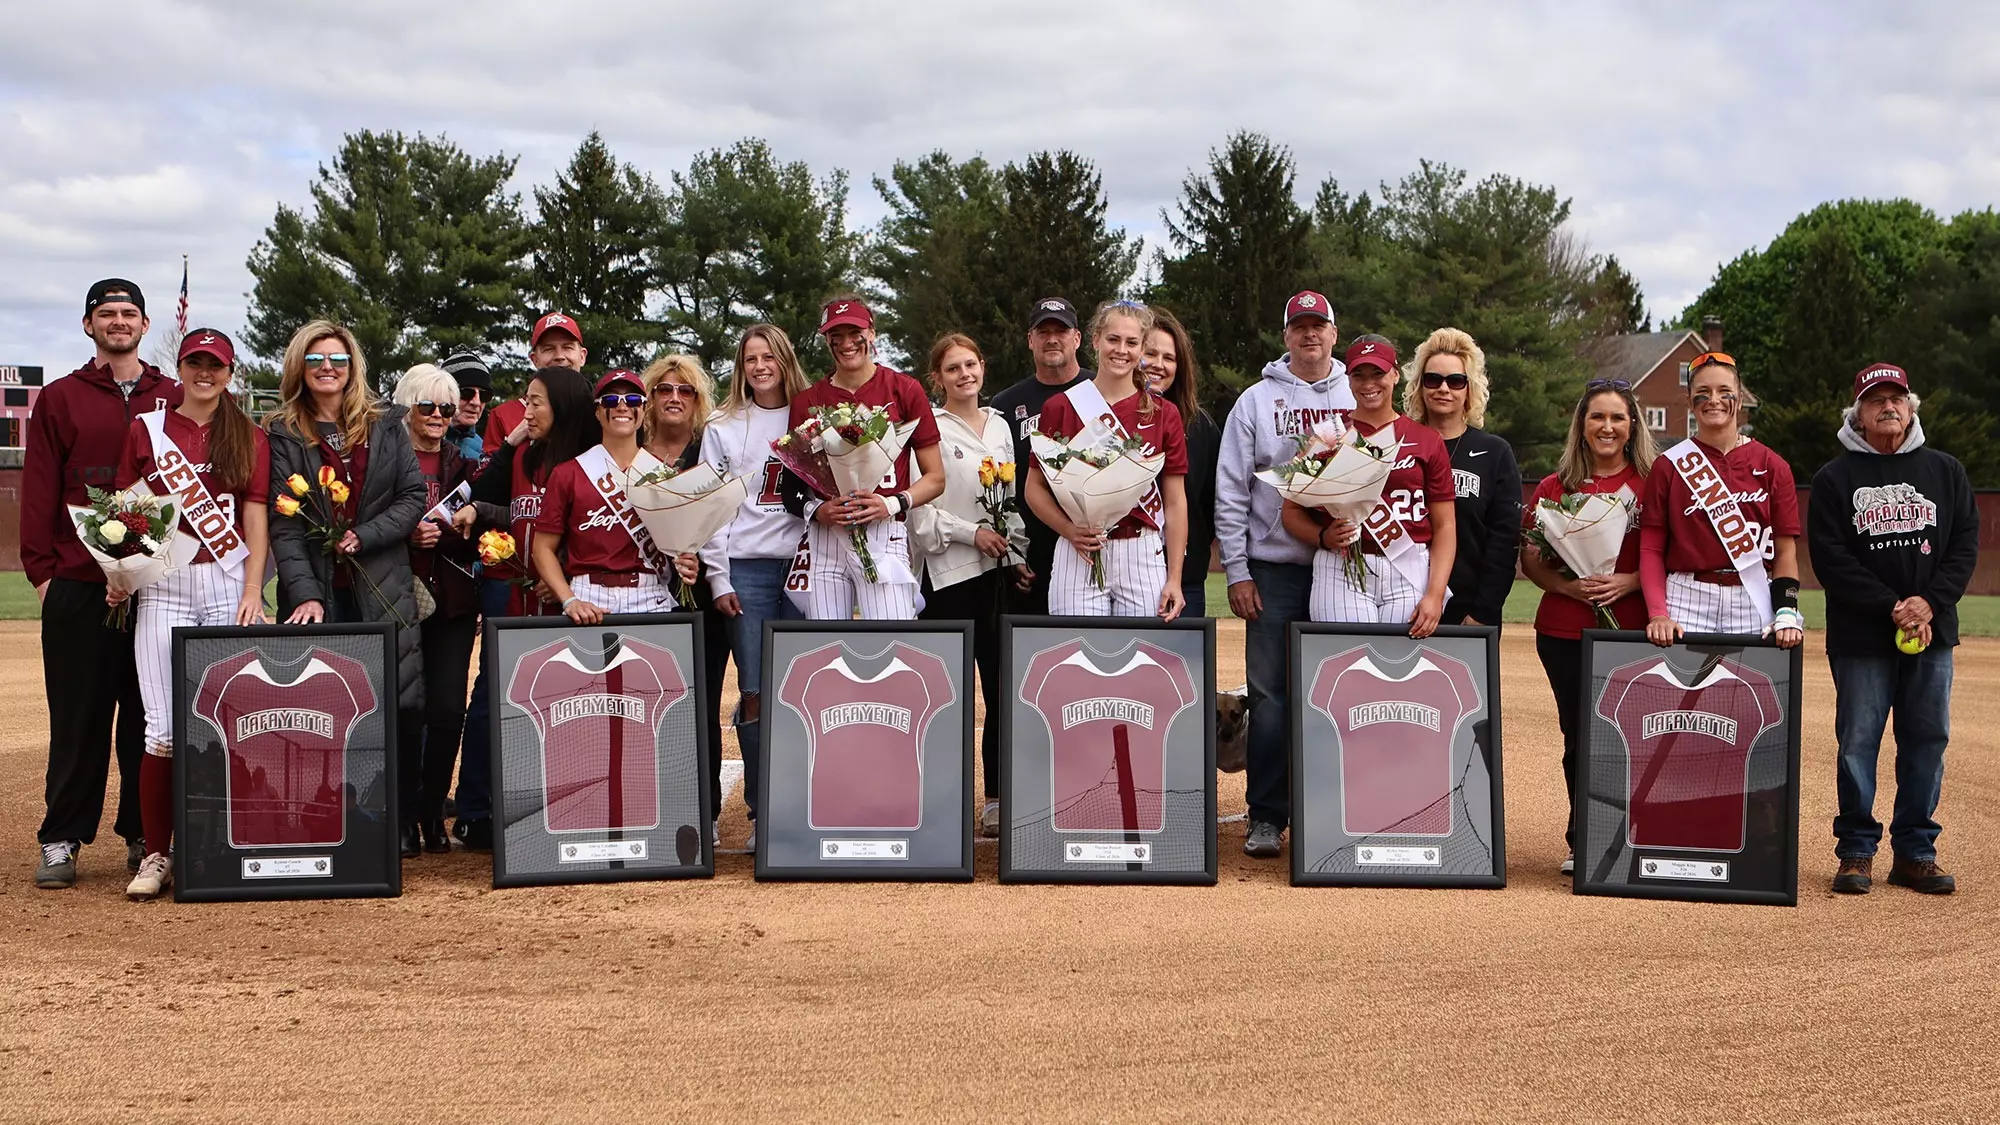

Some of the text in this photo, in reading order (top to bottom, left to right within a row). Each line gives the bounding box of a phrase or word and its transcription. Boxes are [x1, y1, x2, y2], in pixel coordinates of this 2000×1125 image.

[1862, 369, 1901, 383] LAFAYETTE
[187, 500, 215, 522] 2026
[588, 506, 622, 532] Leop
[1390, 490, 1427, 522] 22
[1709, 501, 1736, 521] 2026
[1856, 504, 1934, 530] LAFAYETTE
[1870, 519, 1925, 534] LEOPARDS
[1870, 537, 1922, 551] SOFTBALL
[552, 695, 644, 725] LAFAYETTE
[822, 703, 910, 732] LAFAYETTE
[1064, 699, 1153, 728] LAFAYETTE
[1351, 702, 1439, 731] LAFAYETTE
[239, 709, 332, 740] LAFAYETTE
[1644, 711, 1736, 743] LAFAYETTE
